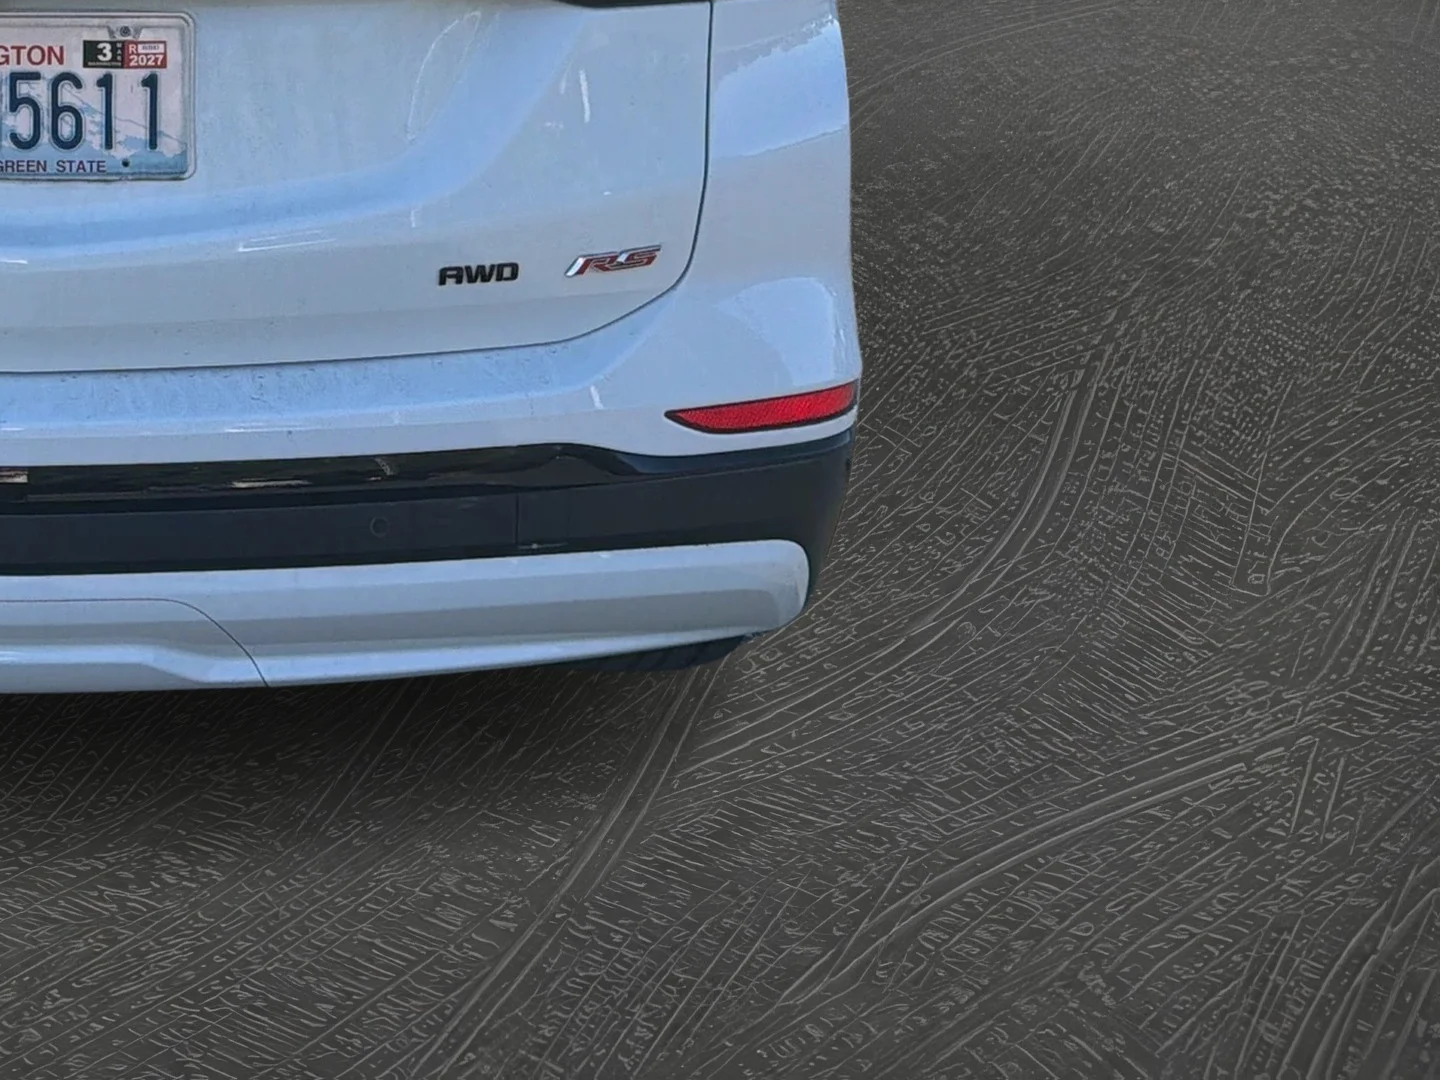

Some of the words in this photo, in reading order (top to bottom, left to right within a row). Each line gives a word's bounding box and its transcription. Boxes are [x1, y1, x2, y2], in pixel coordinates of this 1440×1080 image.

[96, 42, 113, 62] 3
[129, 54, 164, 66] 2027
[56, 160, 107, 174] STATE
[564, 244, 662, 278] RS
[438, 261, 520, 286] AWD
